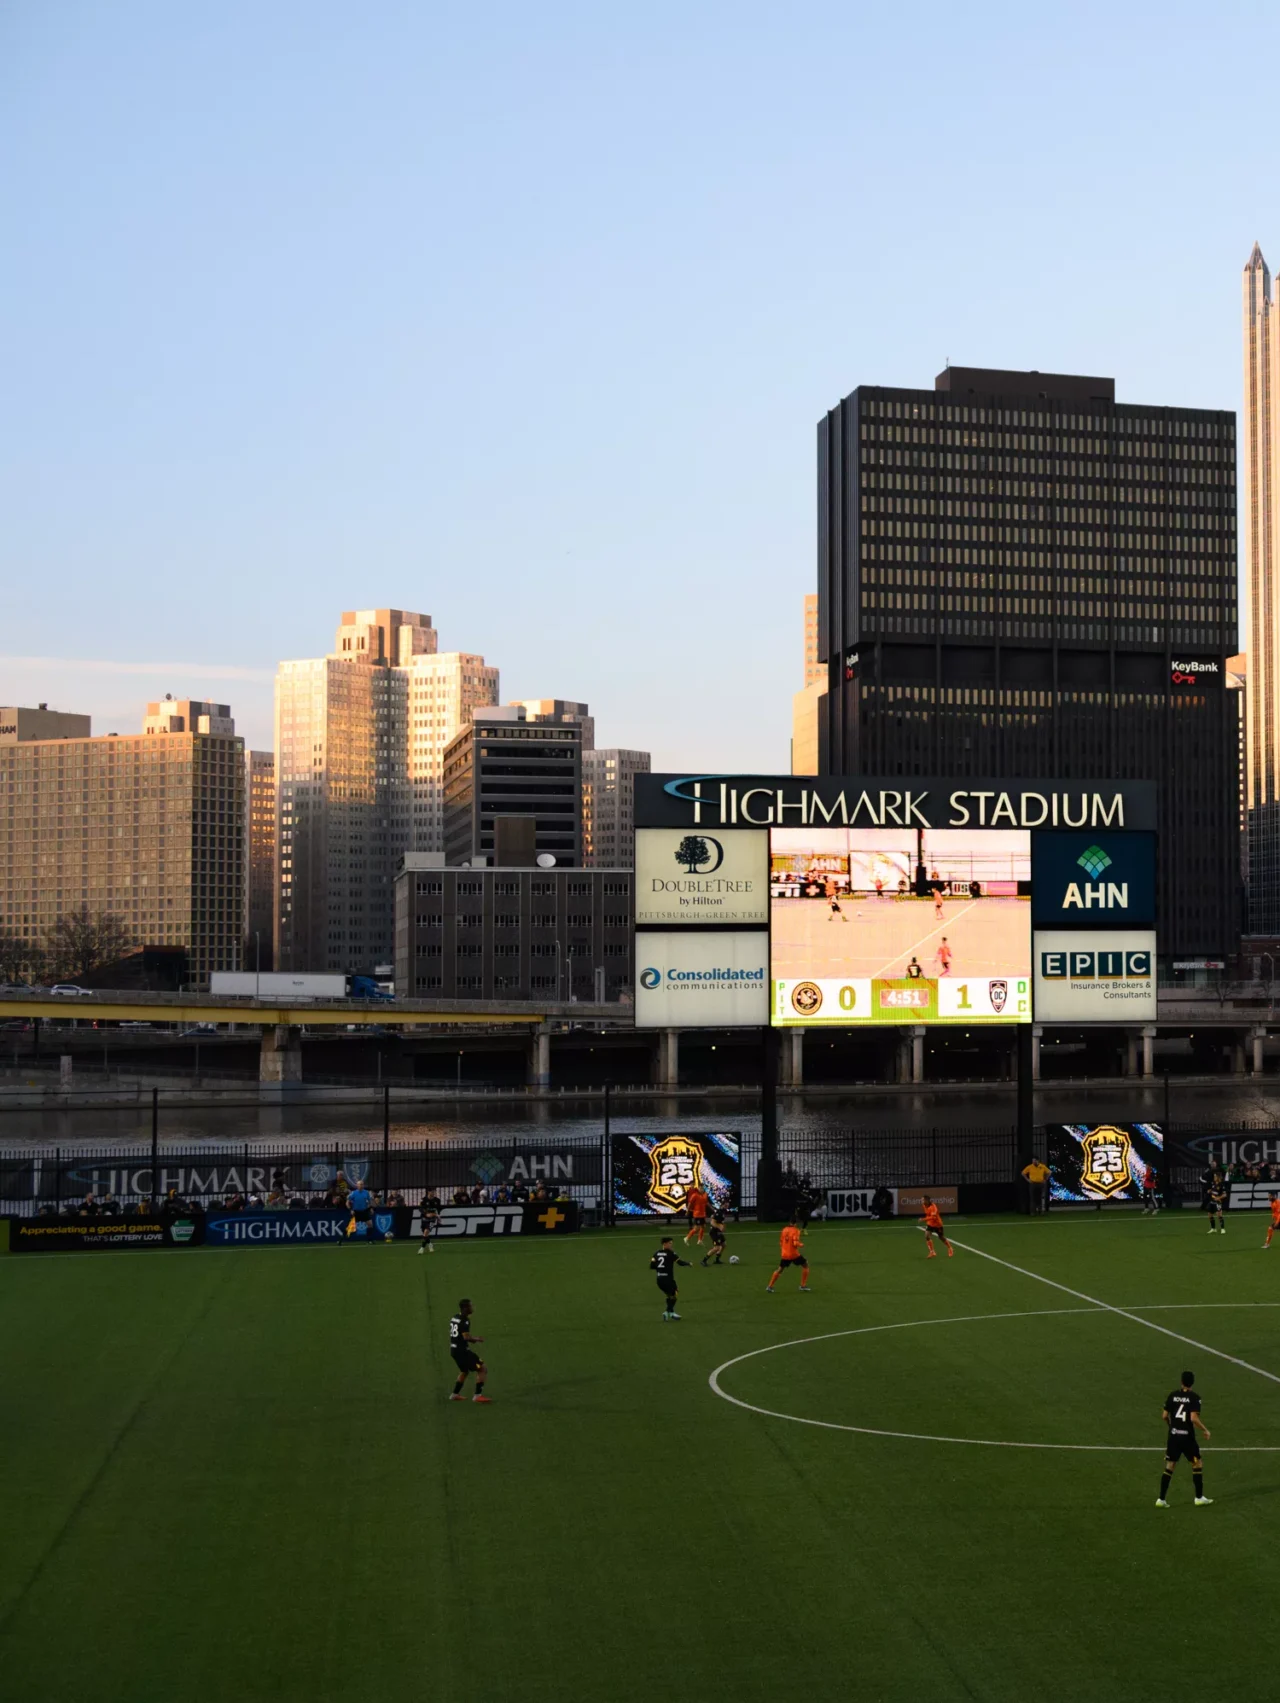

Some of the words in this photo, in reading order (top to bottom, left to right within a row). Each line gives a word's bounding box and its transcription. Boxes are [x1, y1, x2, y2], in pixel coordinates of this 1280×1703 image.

[1171, 660, 1218, 673] KeyBank
[694, 783, 931, 828] HIGHMARK
[949, 791, 1125, 828] STADIUM
[679, 897, 690, 907] by
[692, 896, 722, 905] Hilton
[1062, 883, 1128, 909] AHN
[742, 911, 765, 919] TREE
[1046, 953, 1147, 975] EPIC
[667, 968, 764, 981] Consolidated
[666, 981, 763, 991] communications
[1071, 982, 1110, 990] Insurance
[838, 985, 856, 1010] 0
[888, 990, 921, 1004] 4:51
[956, 984, 973, 1009] 1
[508, 1154, 573, 1180] AHN
[1092, 1151, 1122, 1172] 25
[661, 1163, 694, 1185] 25
[900, 1196, 955, 1206] Chamonship
[20, 1225, 88, 1236] Appreciating
[96, 1225, 128, 1235] good
[129, 1224, 163, 1235] game.
[224, 1219, 344, 1240] HIGHMARK
[109, 1234, 142, 1242] LOTTERY
[657, 1257, 666, 1268] 2
[1174, 1404, 1187, 1422] 4
